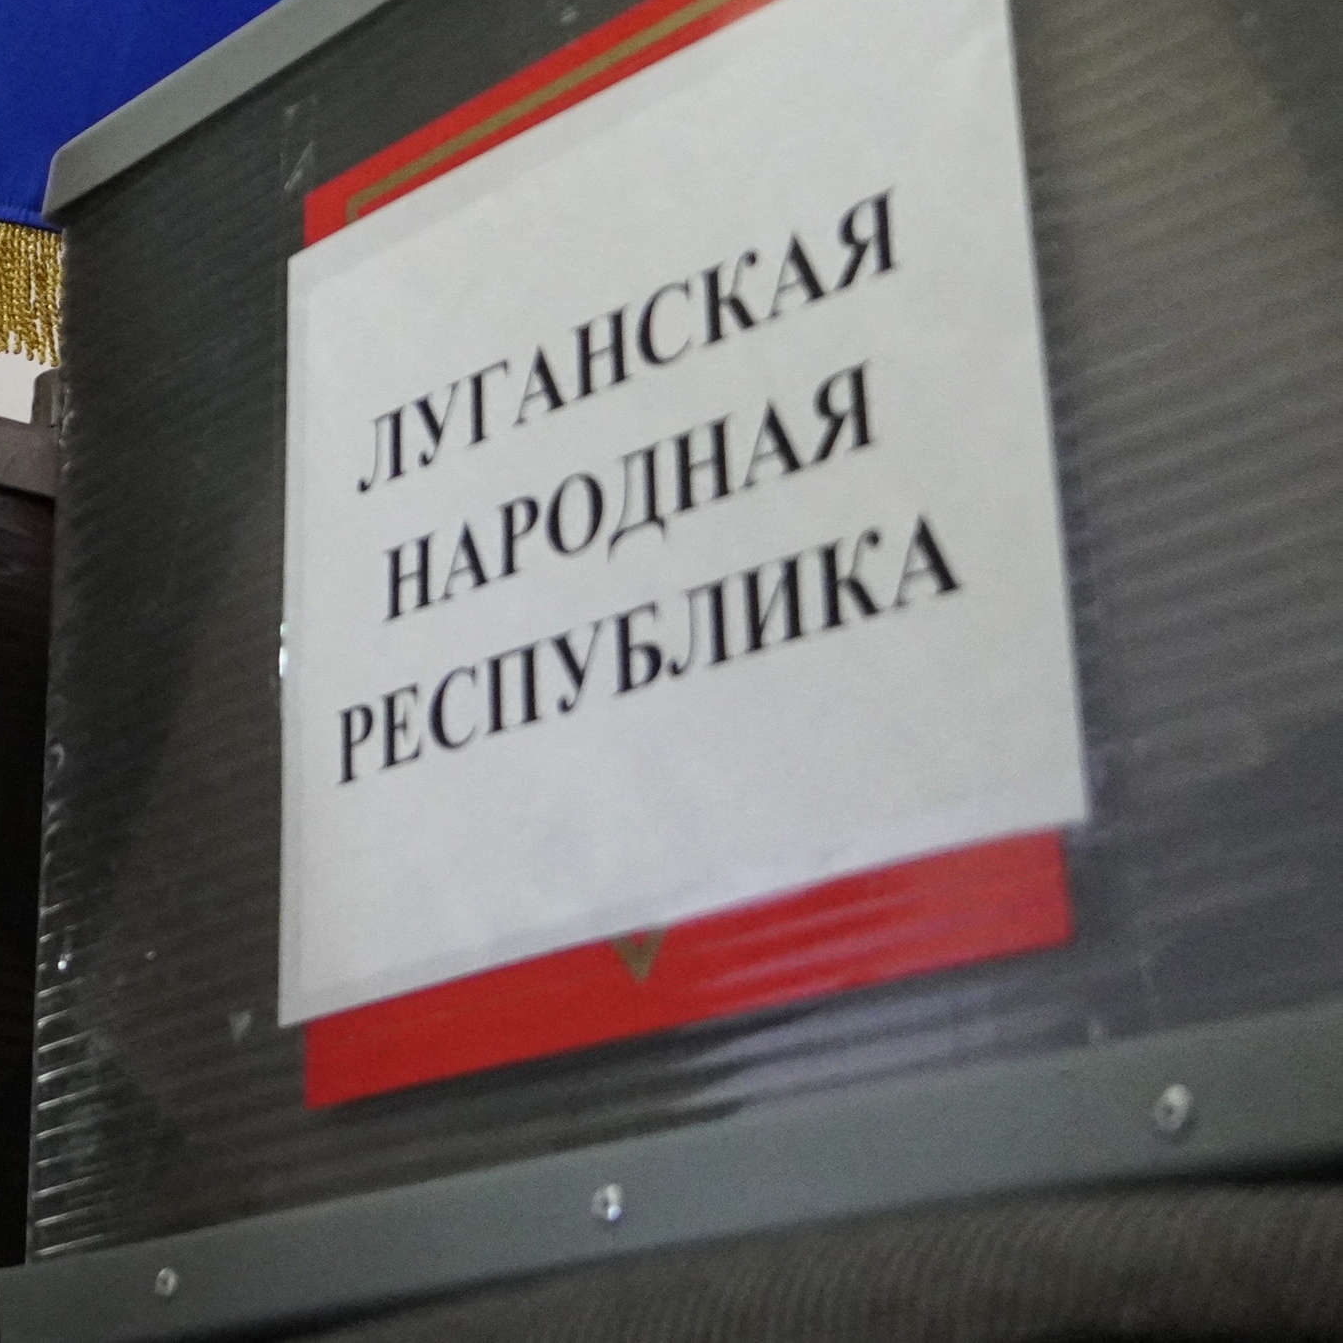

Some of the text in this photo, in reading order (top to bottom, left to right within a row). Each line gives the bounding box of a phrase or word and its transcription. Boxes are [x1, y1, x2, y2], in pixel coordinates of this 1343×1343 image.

[356, 186, 899, 495] ЛУГАНСКАЯ
[383, 359, 877, 624] НАРОДНАЯ
[335, 512, 965, 787] РЕСПУБЛИКА
